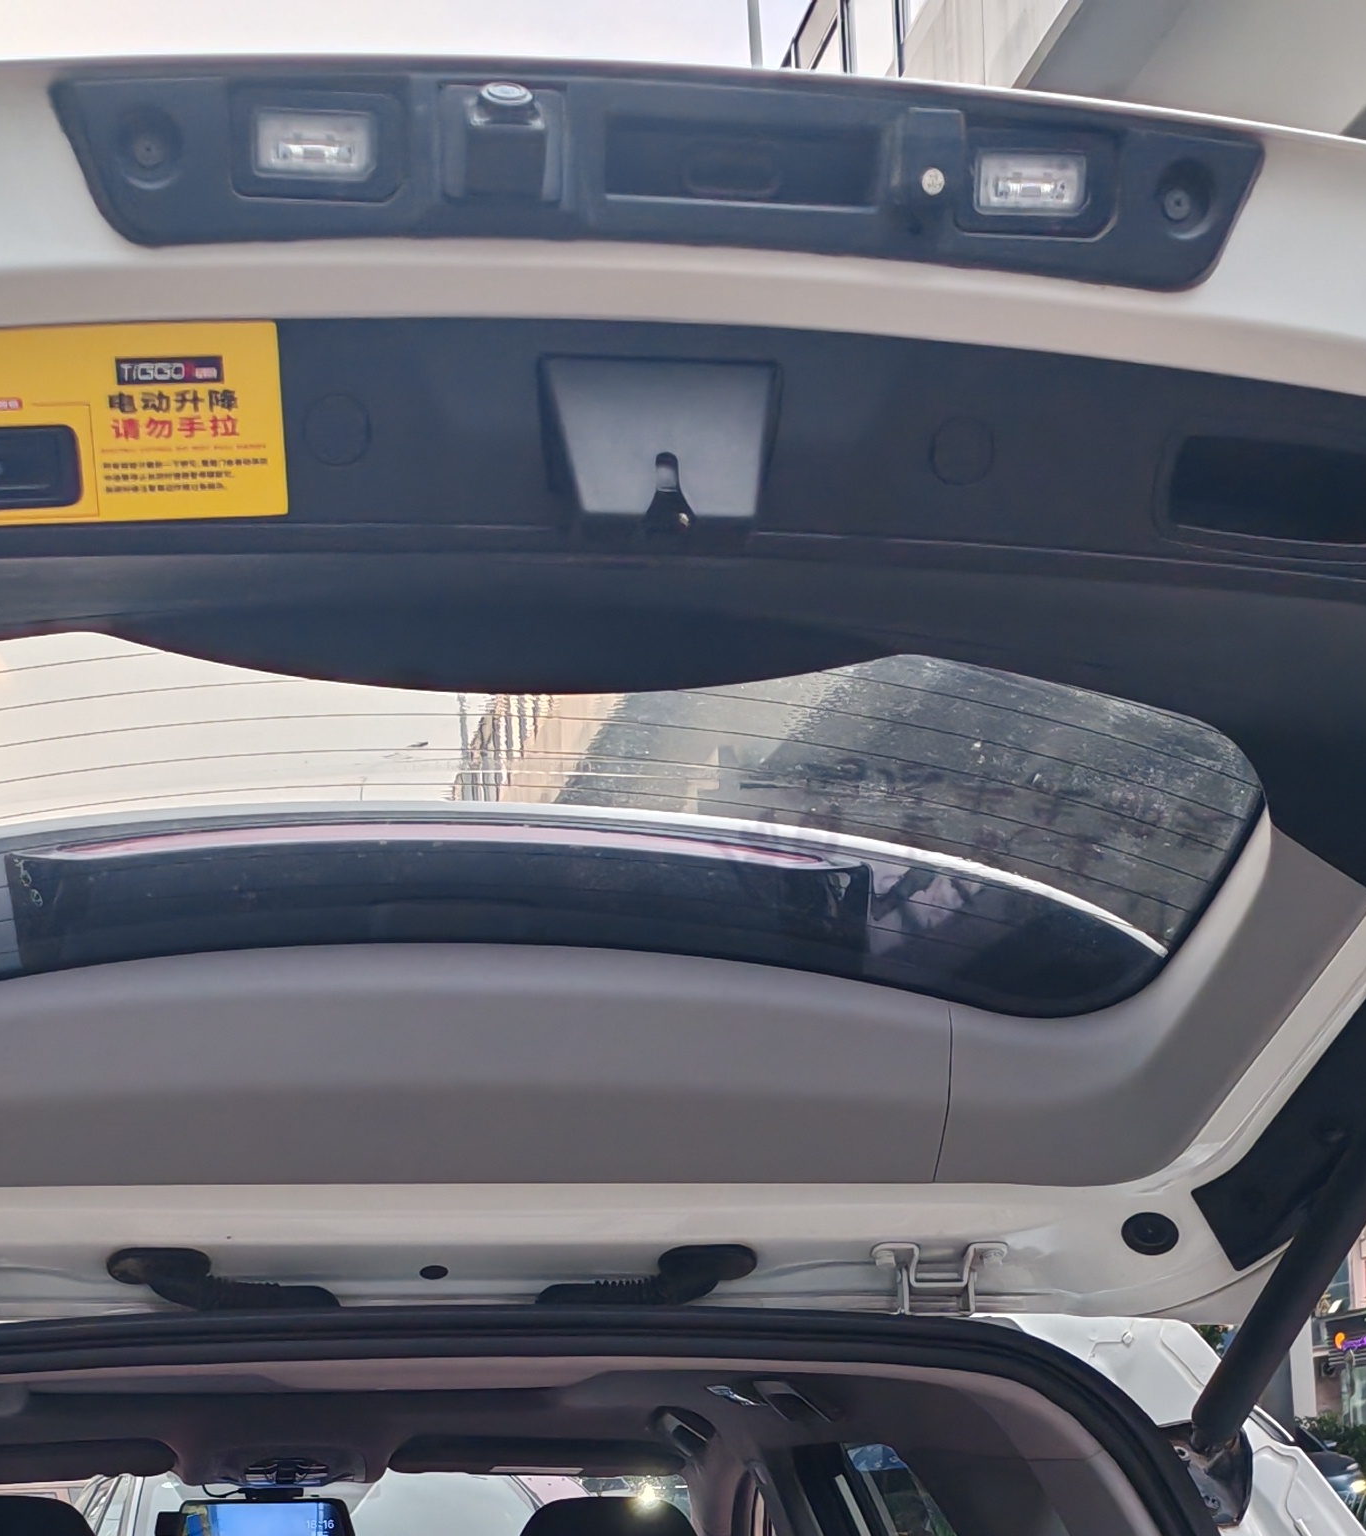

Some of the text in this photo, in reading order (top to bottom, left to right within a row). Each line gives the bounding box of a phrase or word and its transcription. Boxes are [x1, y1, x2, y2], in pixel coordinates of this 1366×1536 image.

[108, 390, 238, 414] 电动升降
[111, 415, 239, 441] 请勿手拉
